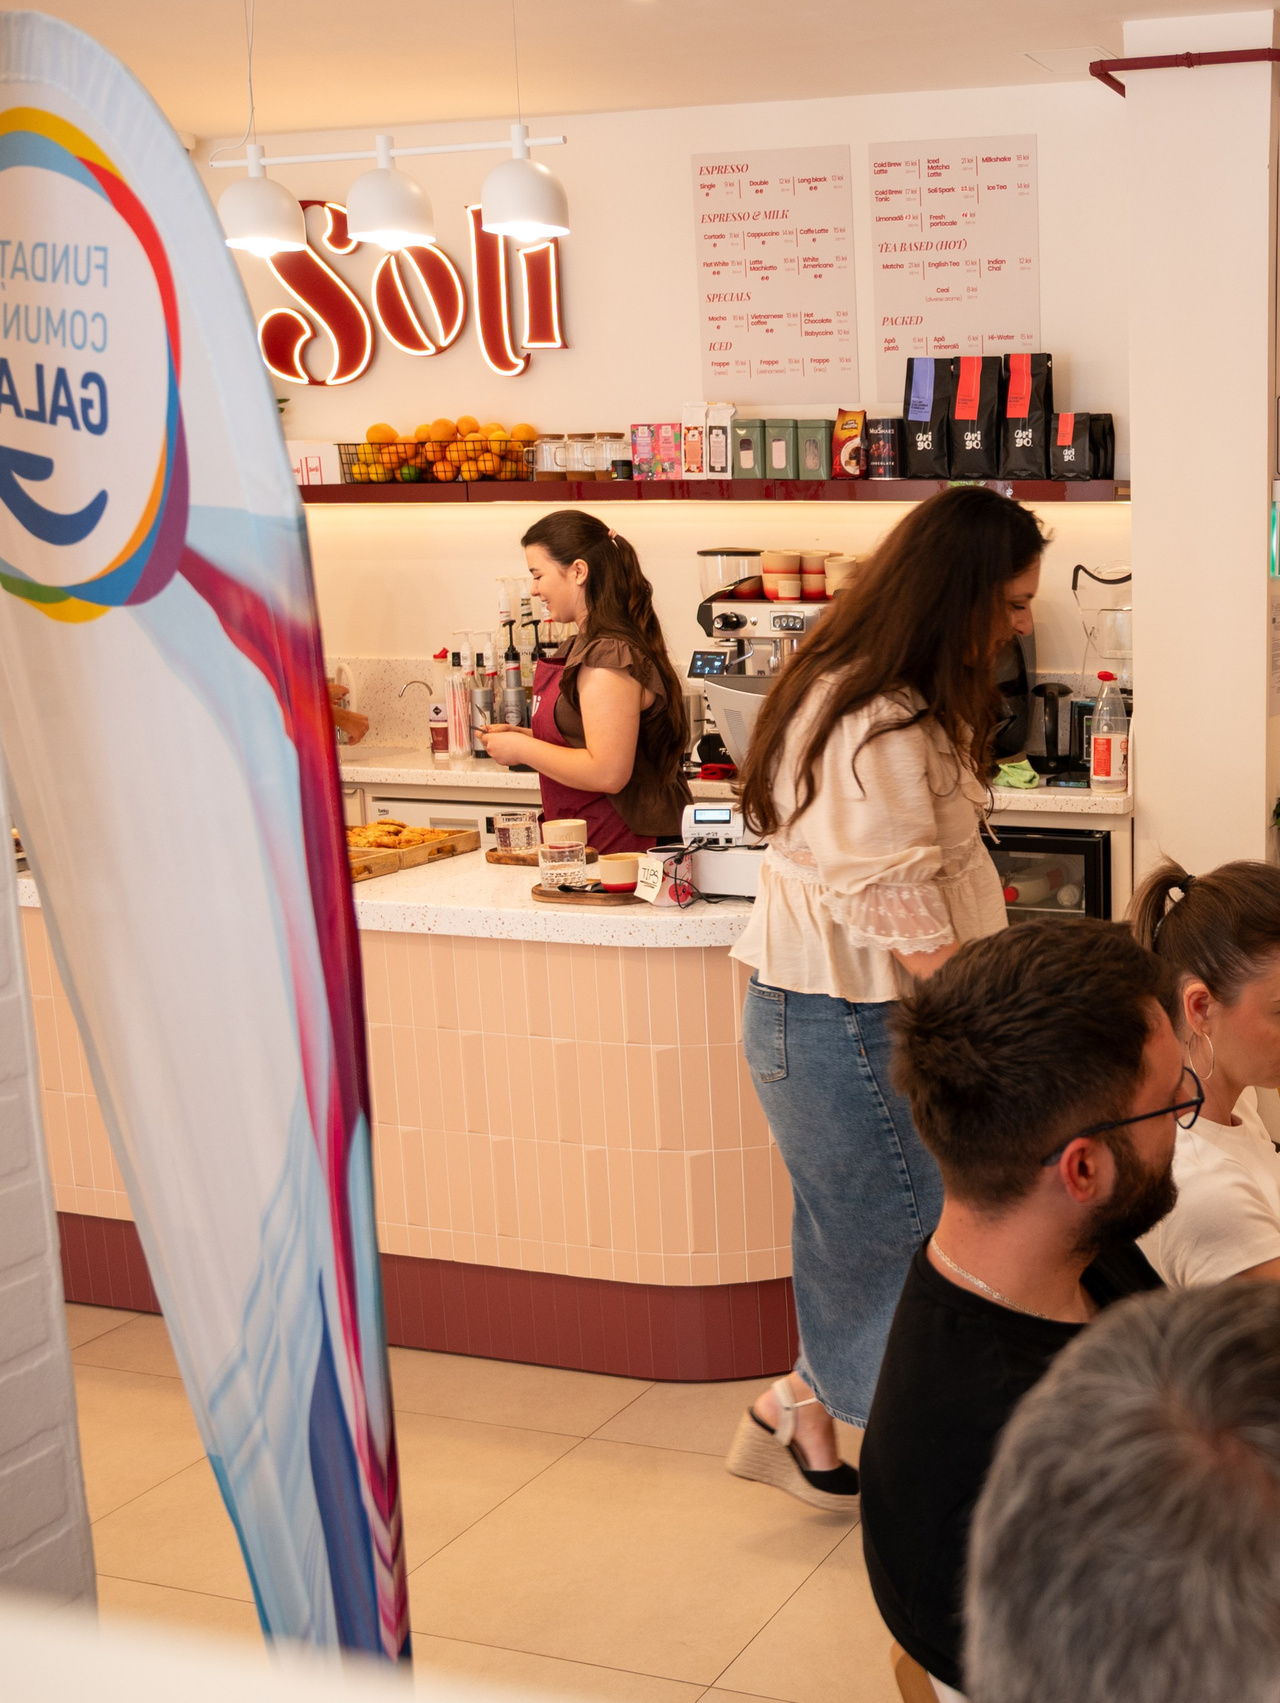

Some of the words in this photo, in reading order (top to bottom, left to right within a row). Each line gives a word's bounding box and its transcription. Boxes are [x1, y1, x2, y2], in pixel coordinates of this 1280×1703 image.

[699, 164, 749, 175] ESPRESSO
[701, 212, 750, 223] ESPRESSO
[752, 211, 761, 221] &
[764, 210, 789, 220] MILK
[930, 220, 957, 228] portocale
[747, 230, 780, 238] Cappuccino
[878, 242, 897, 253] TEA
[900, 241, 933, 252] BASED
[936, 239, 967, 251] (HOT)
[928, 261, 948, 269] English
[706, 292, 751, 303] SPECIALS
[882, 316, 923, 326] PACKED
[709, 342, 732, 351] ICED
[642, 867, 659, 884] TIPS
